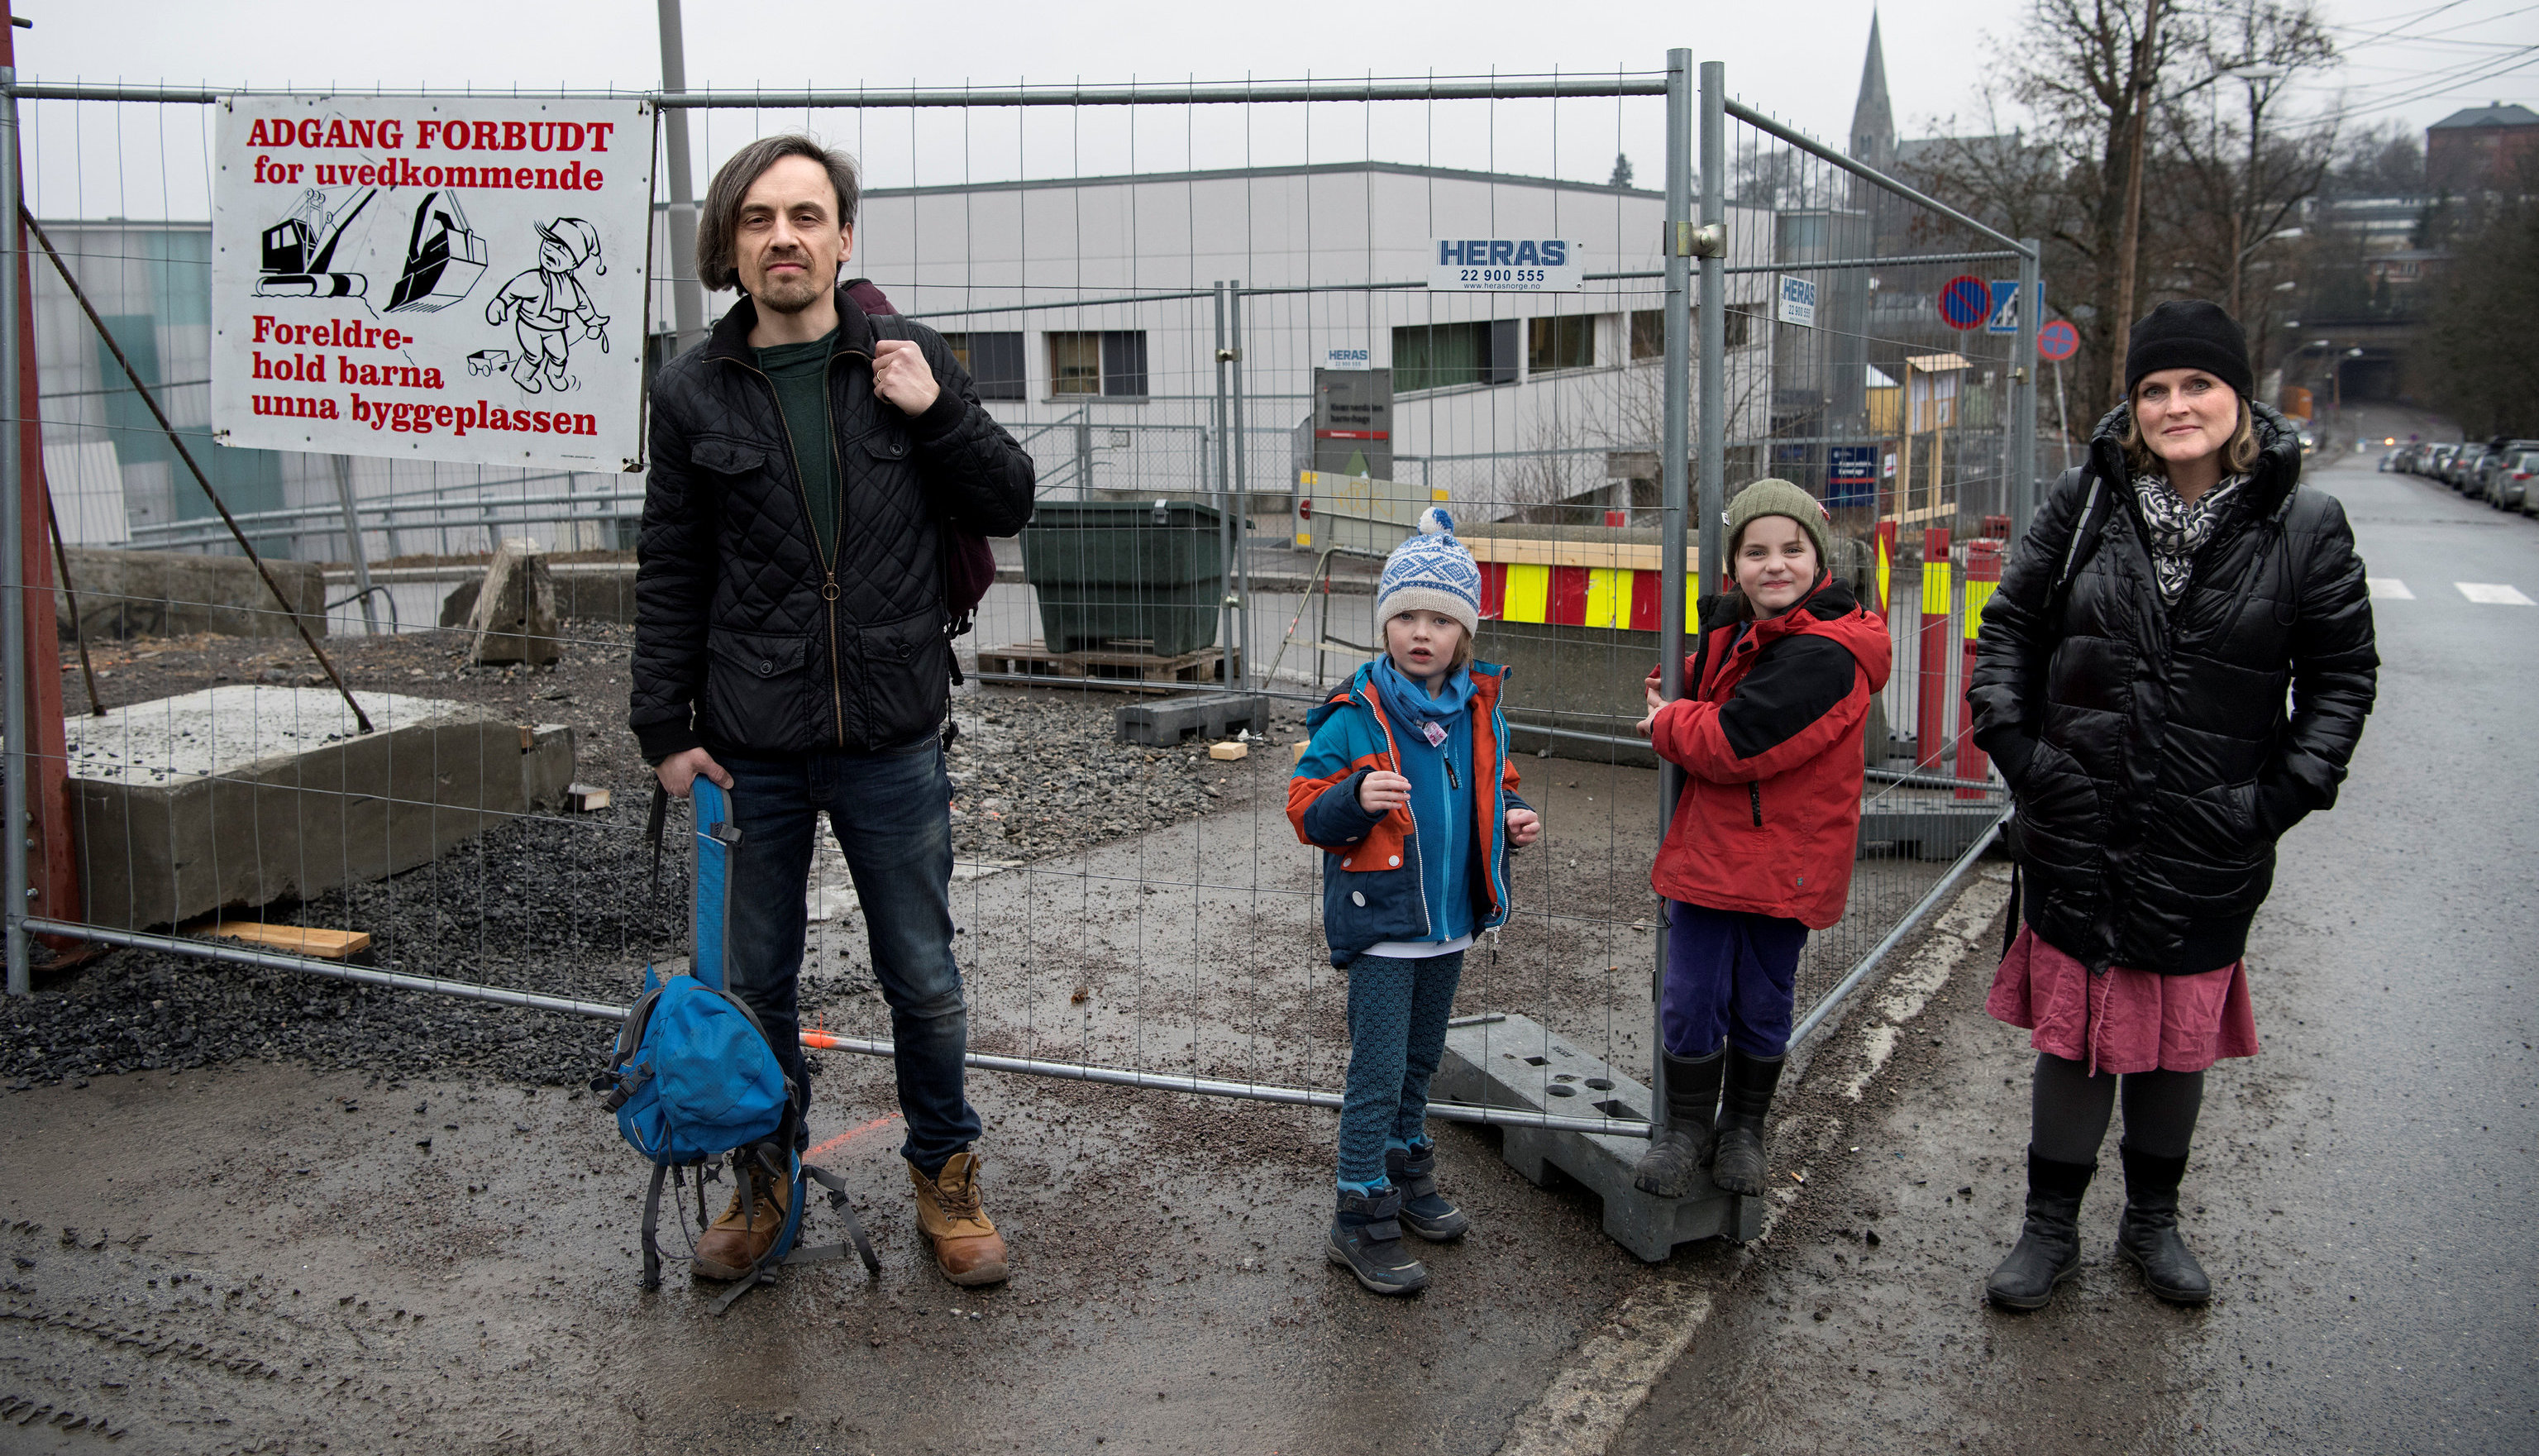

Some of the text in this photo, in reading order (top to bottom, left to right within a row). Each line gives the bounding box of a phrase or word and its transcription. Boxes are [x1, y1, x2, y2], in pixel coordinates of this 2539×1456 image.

[246, 118, 614, 153] ADGANG FORBUDT
[254, 154, 604, 192] for uvedkommende
[1439, 240, 1566, 266] HERAS
[1460, 269, 1544, 282] 22 900 555
[1463, 282, 1541, 290] www.herasnorge.no
[1783, 277, 1815, 307] HERAS
[252, 314, 414, 352] Foreldre-
[251, 351, 446, 390] hold barna
[1329, 350, 1368, 360] HERAS
[251, 392, 599, 437] unna byggeplassen
